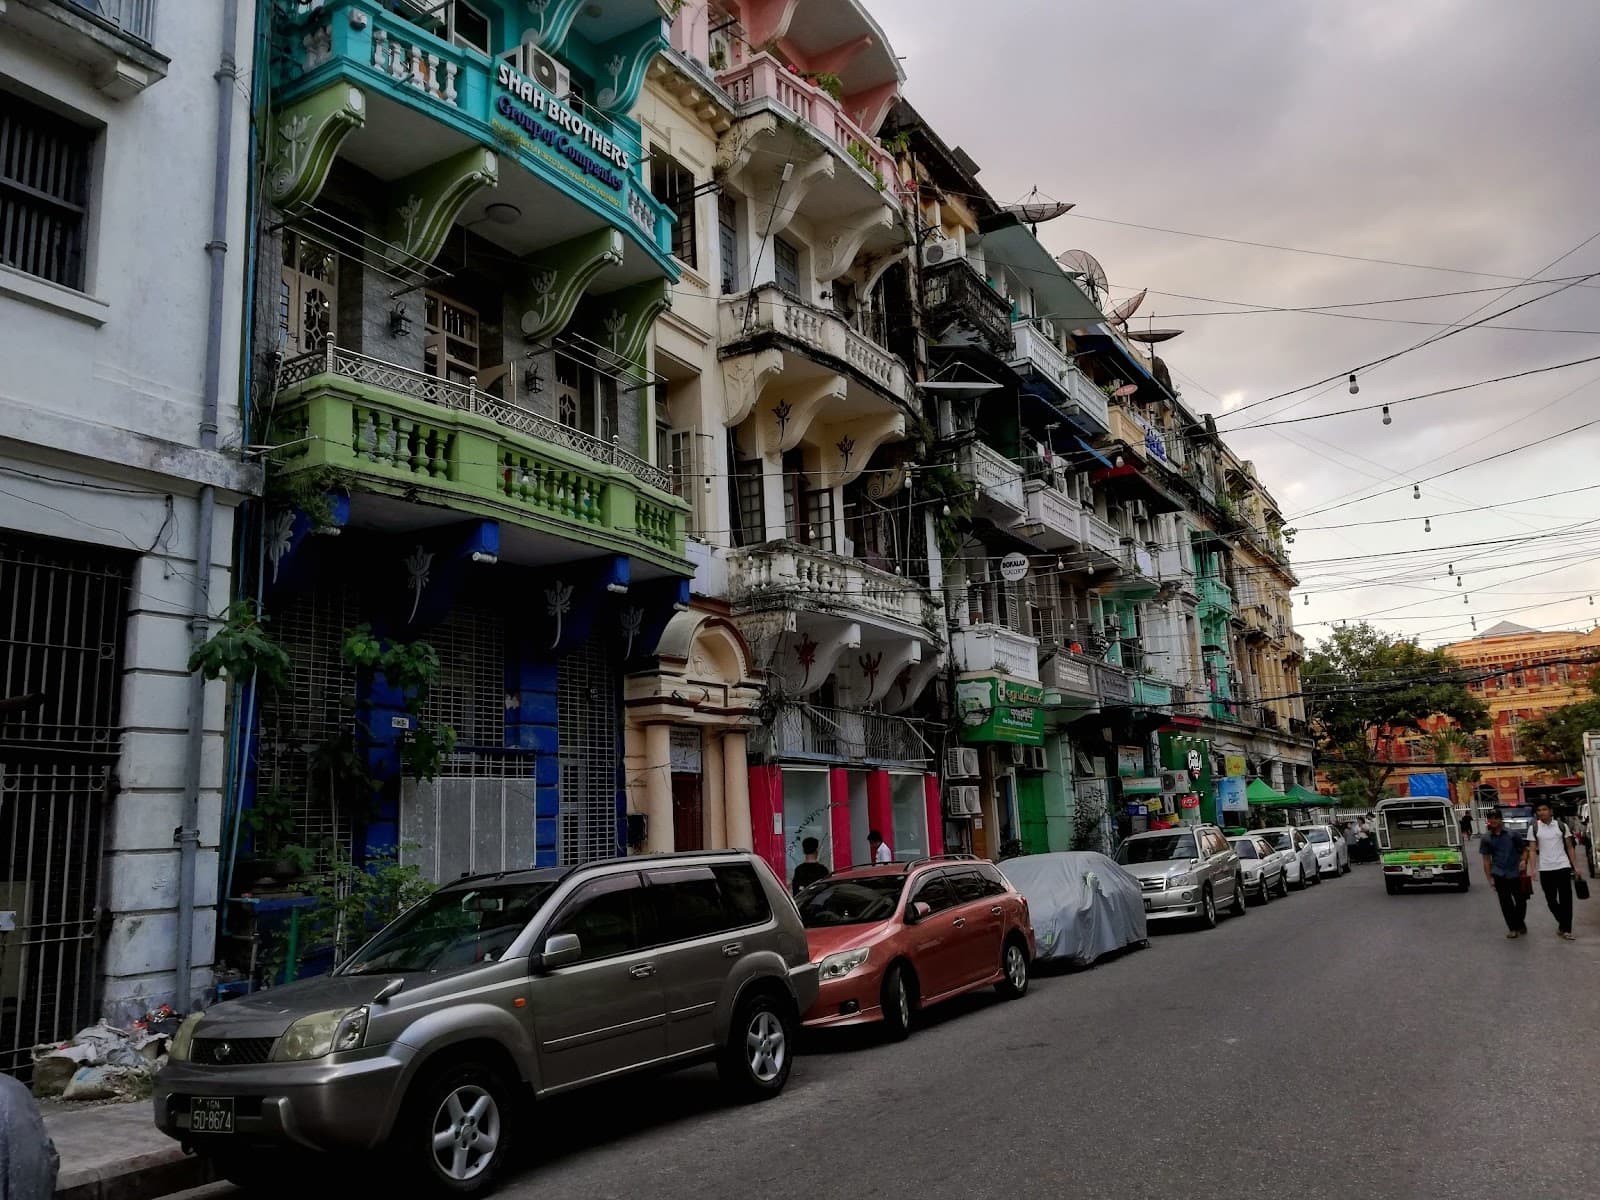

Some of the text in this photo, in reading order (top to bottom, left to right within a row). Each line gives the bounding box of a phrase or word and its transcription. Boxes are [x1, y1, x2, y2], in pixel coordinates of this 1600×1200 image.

[498, 63, 545, 111] SHAH
[548, 99, 629, 170] BROTHERS
[498, 95, 542, 141] Group
[542, 128, 558, 147] of
[557, 135, 624, 192] Companies
